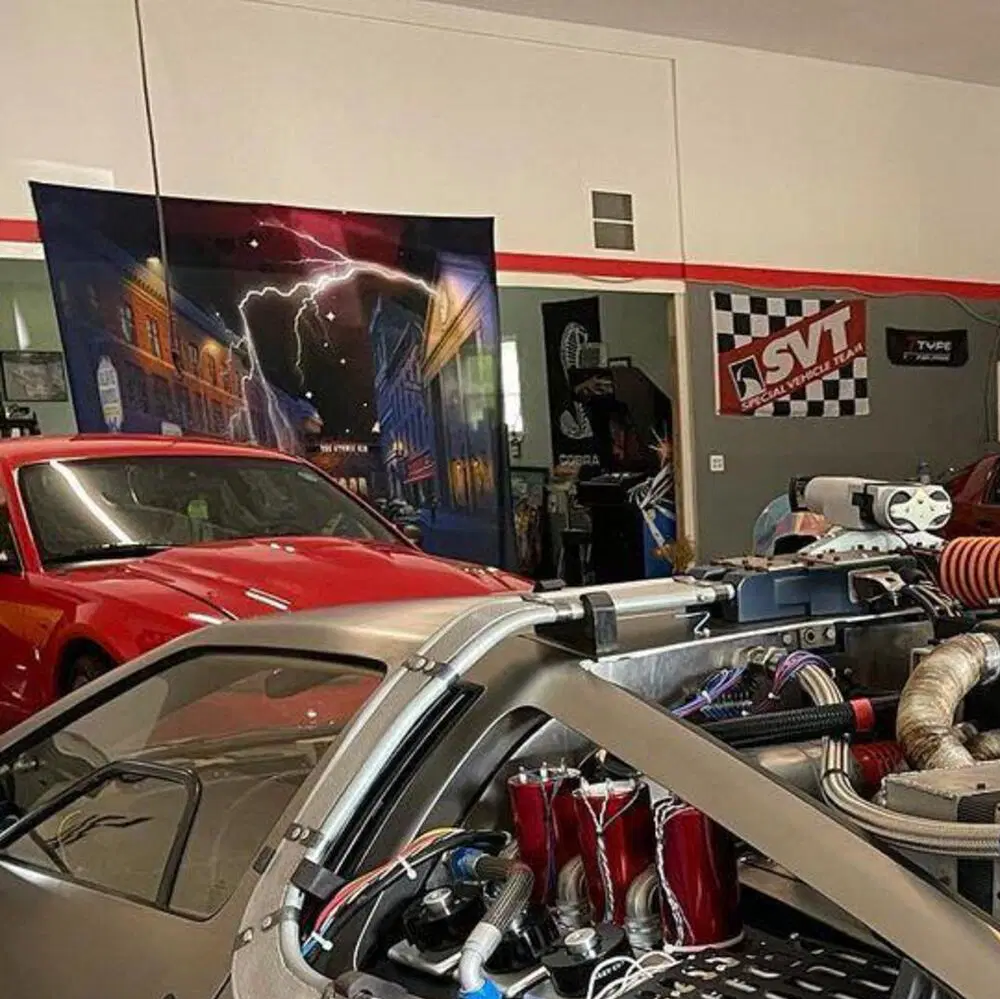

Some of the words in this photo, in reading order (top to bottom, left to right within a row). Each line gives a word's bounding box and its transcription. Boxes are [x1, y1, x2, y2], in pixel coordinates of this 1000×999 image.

[741, 386, 787, 412] SPECIAL
[787, 361, 830, 389] VEHICLE
[832, 343, 864, 365] TEAM
[761, 305, 851, 386] SVT
[558, 453, 601, 467] COBRA
